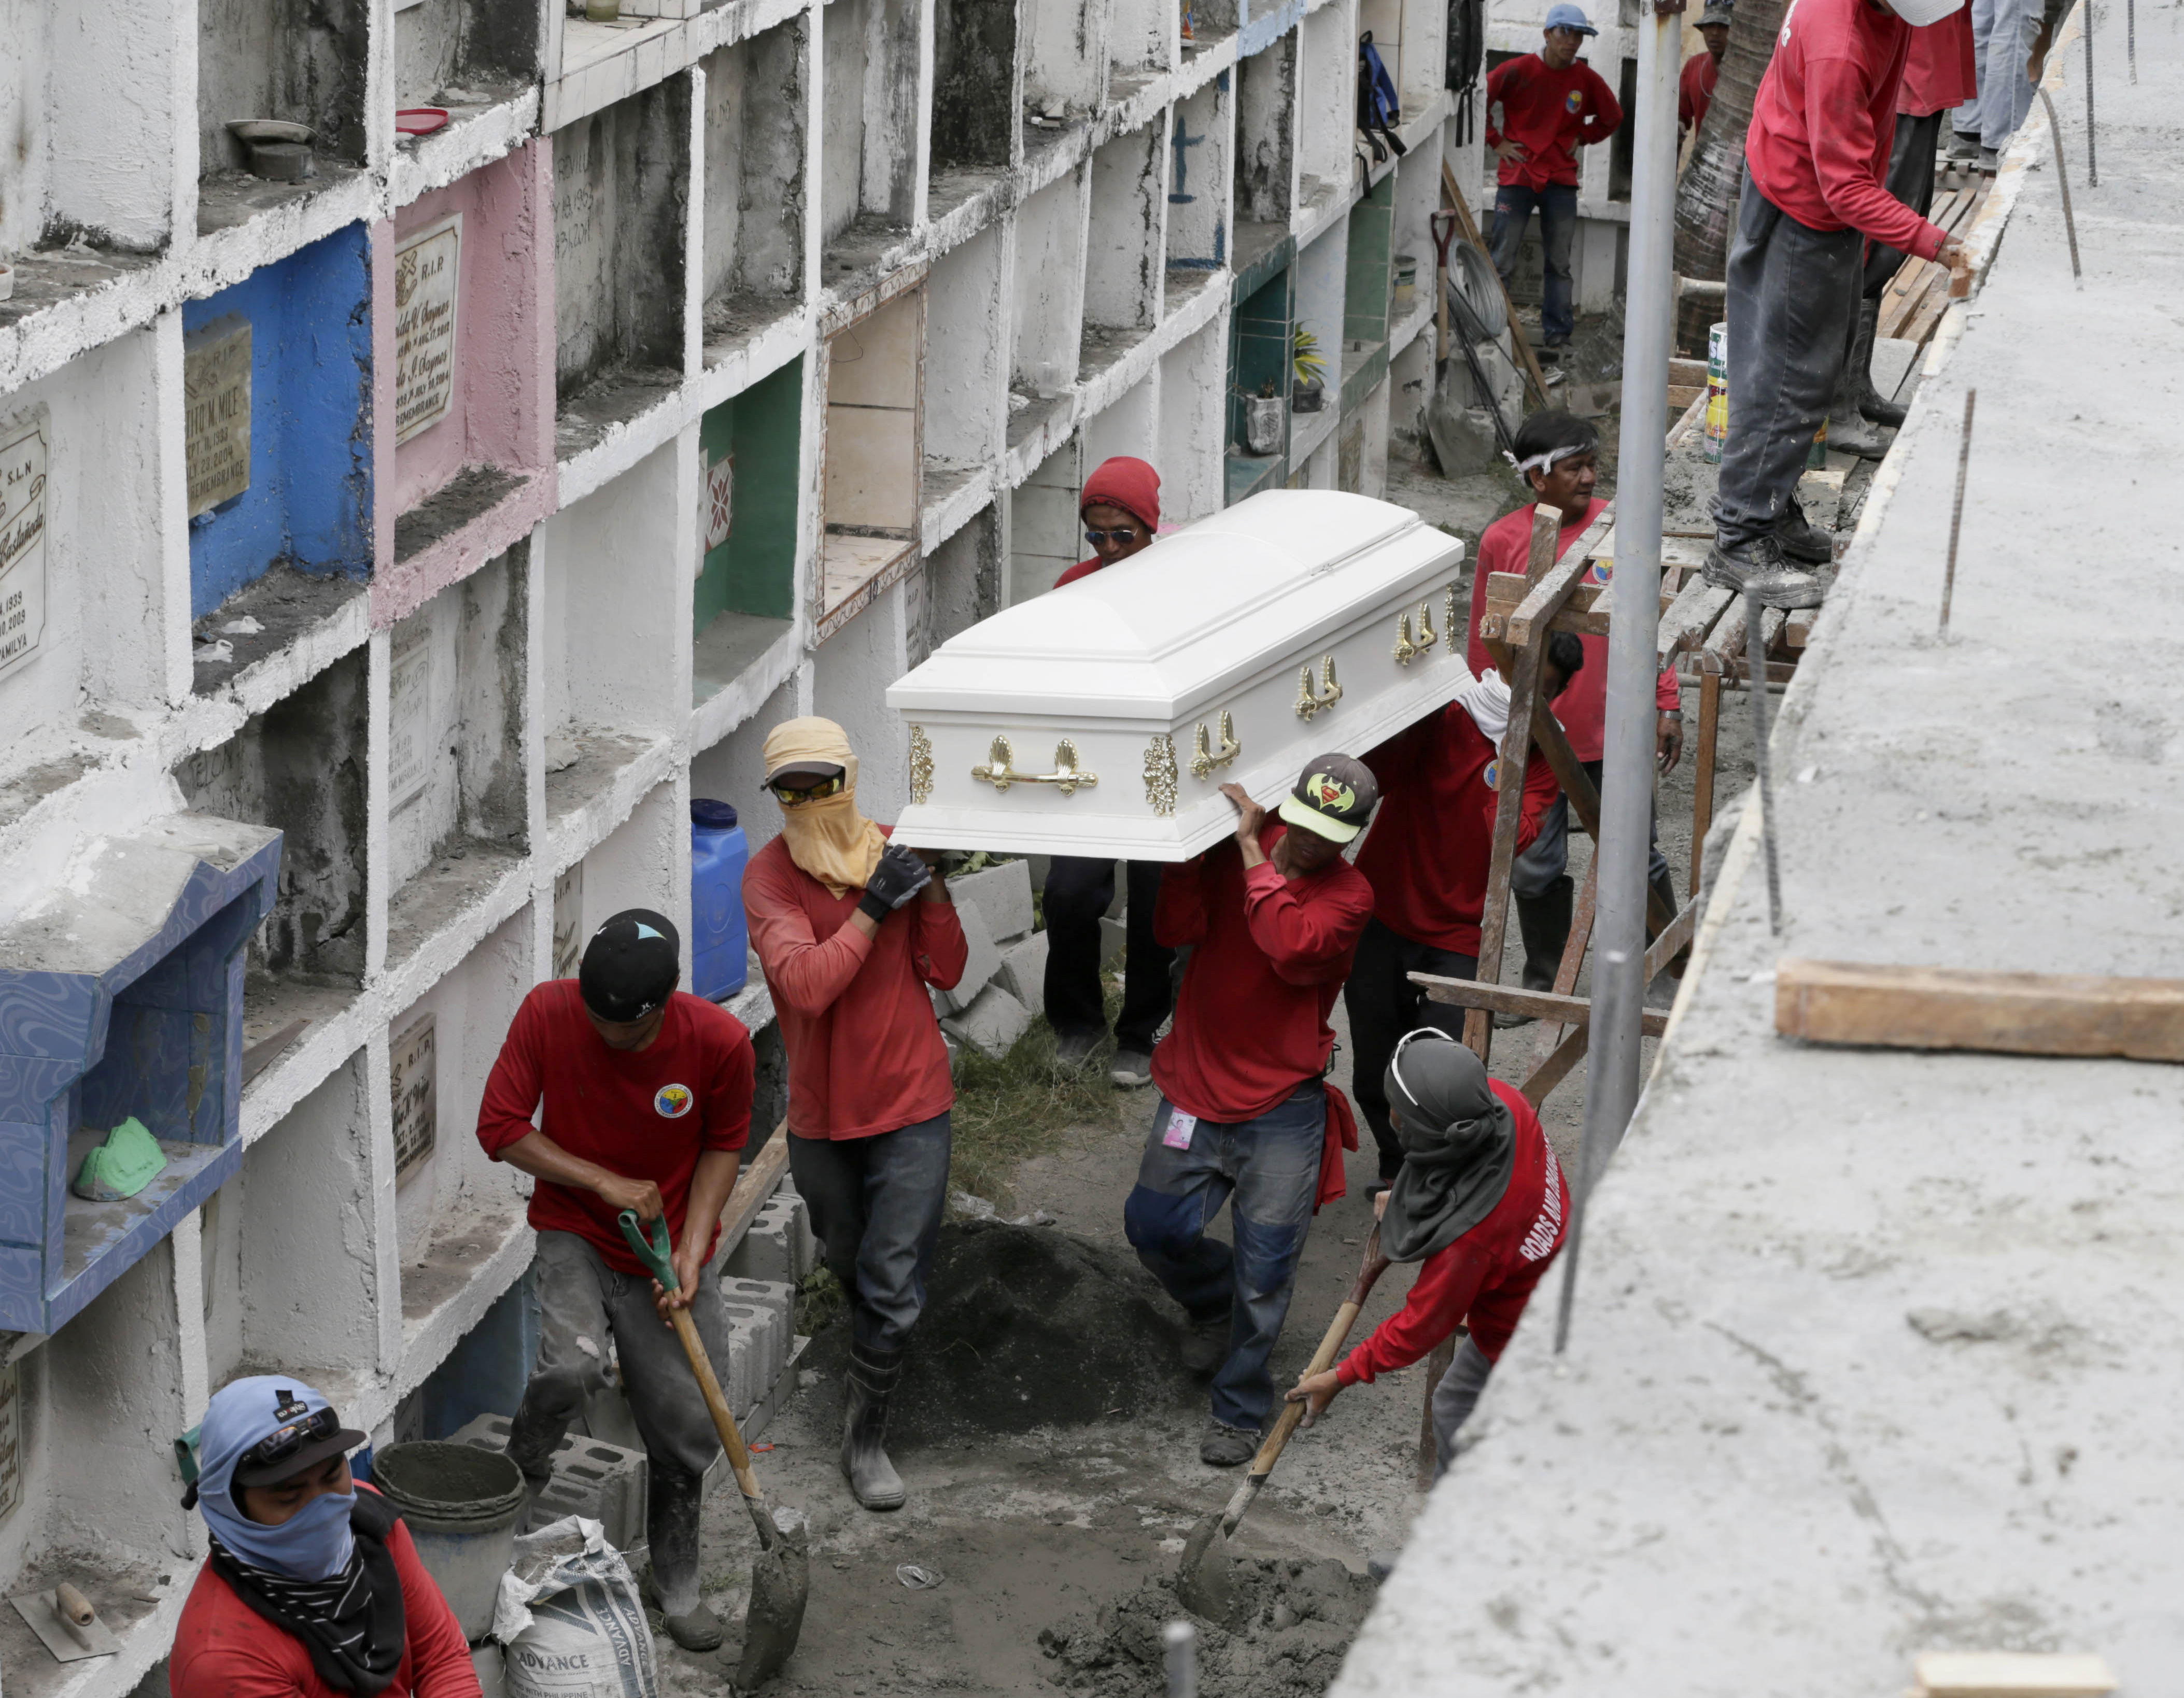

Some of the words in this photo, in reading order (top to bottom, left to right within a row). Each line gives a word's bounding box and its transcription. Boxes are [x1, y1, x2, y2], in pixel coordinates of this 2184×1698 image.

[219, 386, 238, 423] MILE
[190, 459, 244, 500] REMEMBRANCE
[1519, 1214, 1559, 1262] ROADS
[1542, 1187, 1561, 1227] AND
[519, 1651, 589, 1671] ADVANCE
